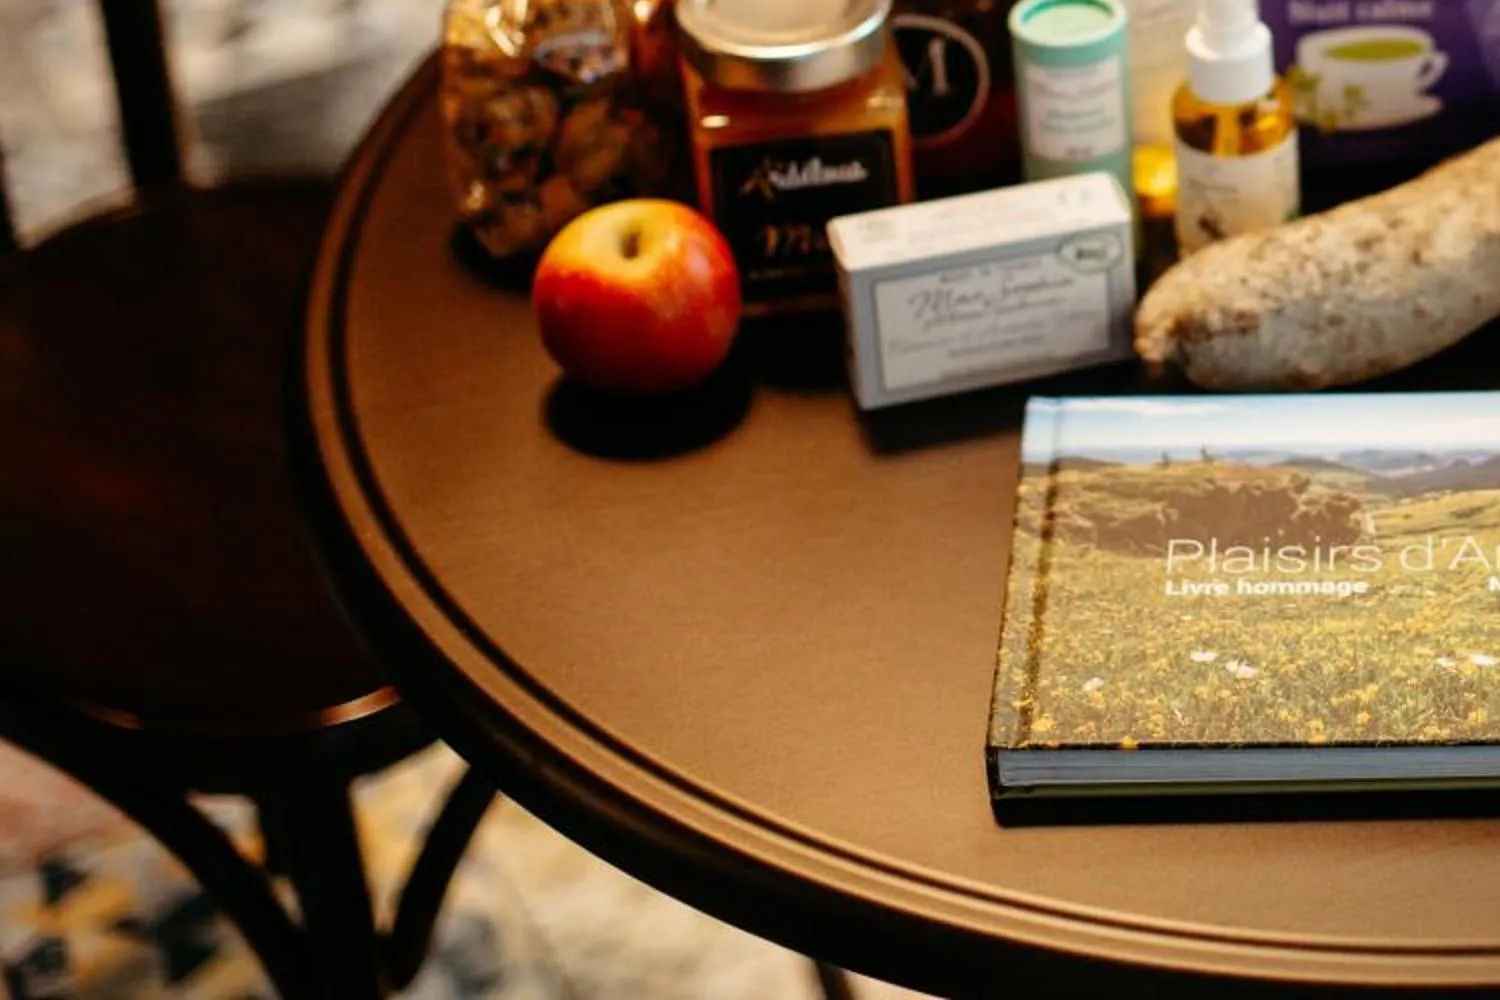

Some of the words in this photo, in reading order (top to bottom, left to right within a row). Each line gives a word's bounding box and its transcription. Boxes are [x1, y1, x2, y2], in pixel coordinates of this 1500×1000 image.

[1166, 535, 1384, 575] Plaisirs
[1164, 578, 1230, 597] Livre
[1236, 577, 1371, 597] hommage
